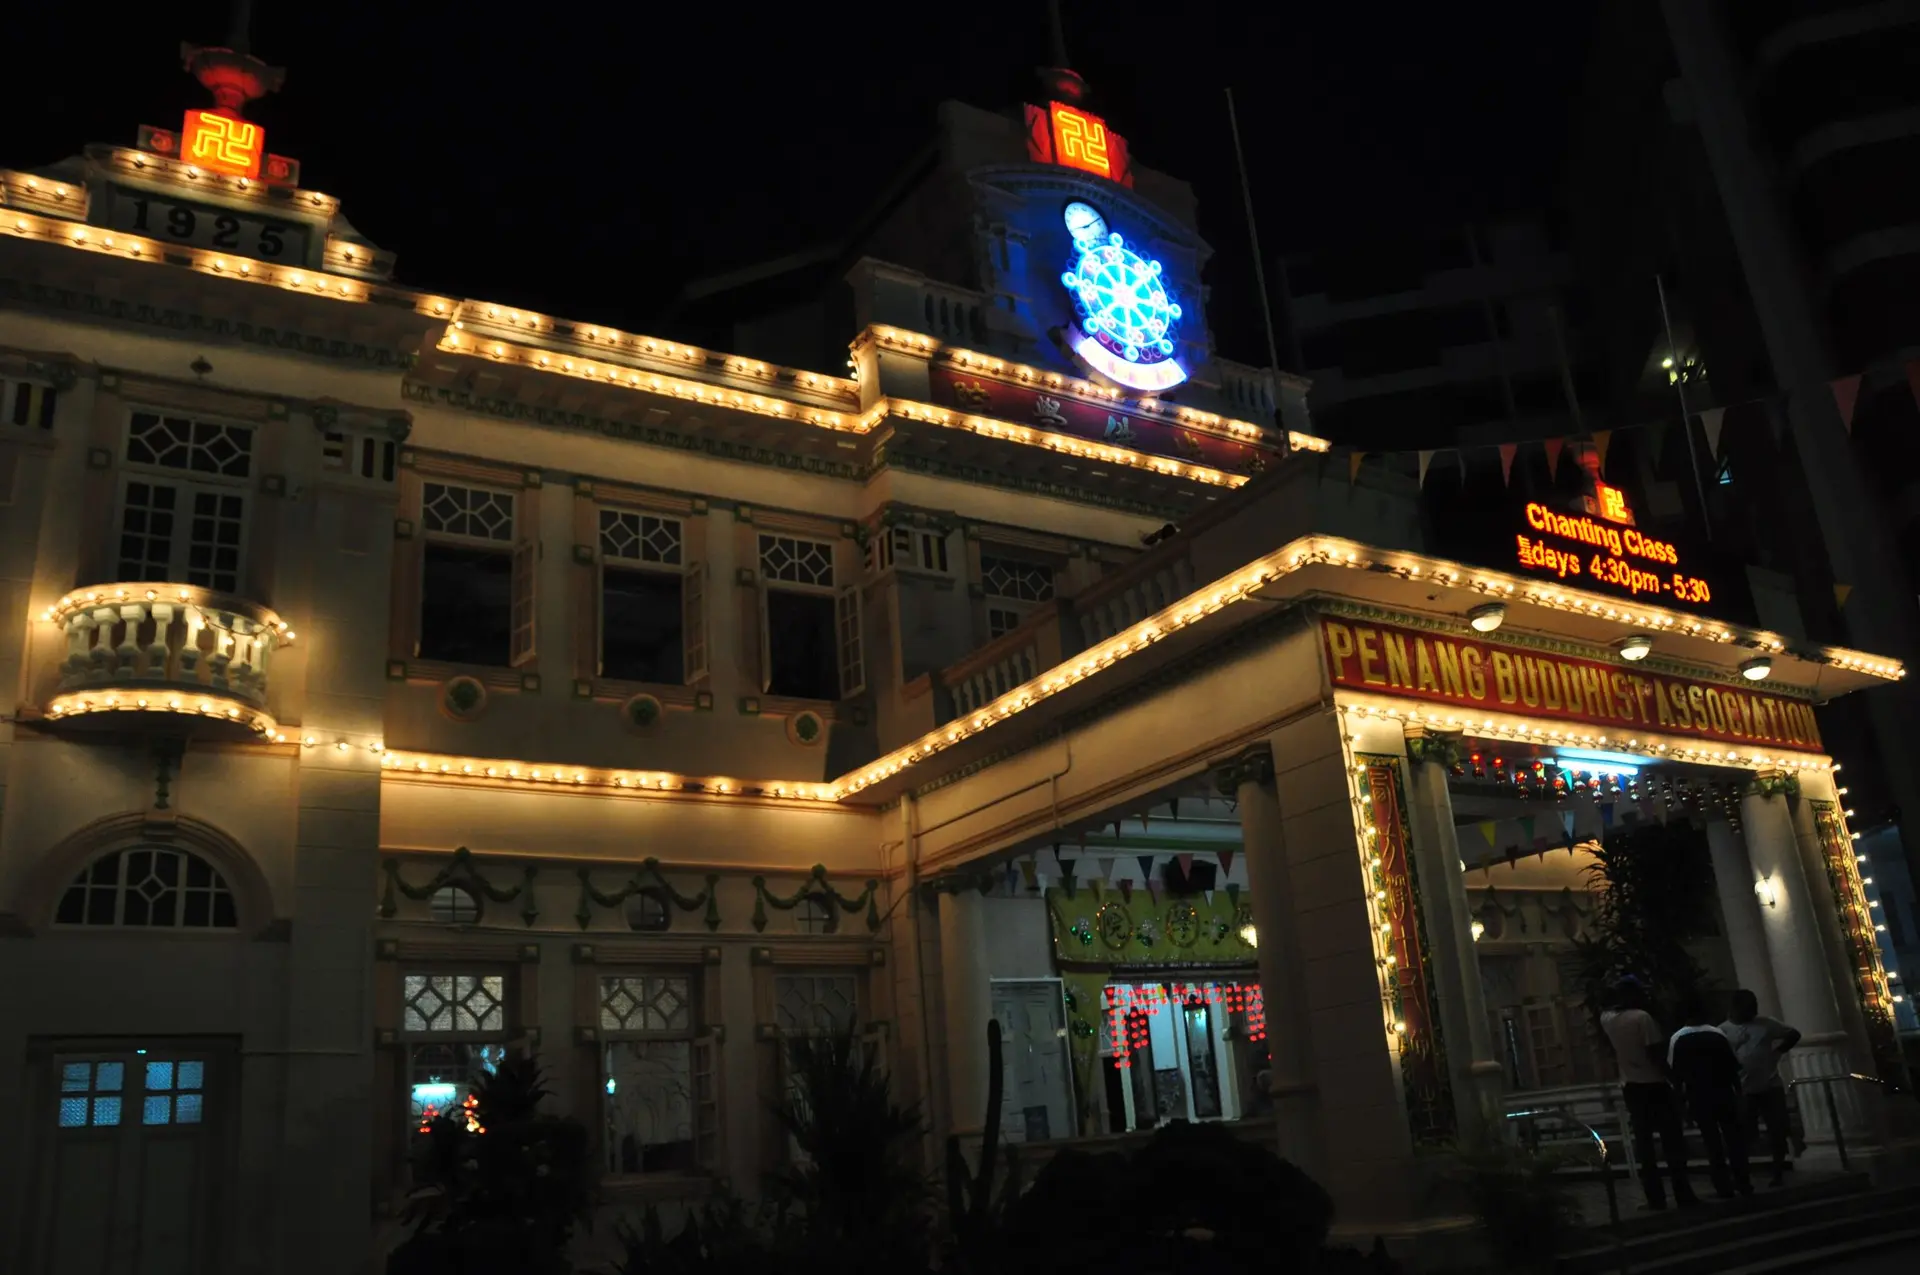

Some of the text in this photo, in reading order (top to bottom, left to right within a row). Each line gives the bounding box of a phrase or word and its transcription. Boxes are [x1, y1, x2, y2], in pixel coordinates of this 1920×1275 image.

[133, 200, 287, 256] 1925
[1526, 503, 1678, 564] Chanting Class
[1589, 554, 1660, 594] 4:30pm
[1673, 574, 1711, 602] 5:30
[1326, 622, 1822, 748] PENANG BUDDHIST ASSOCIATION
